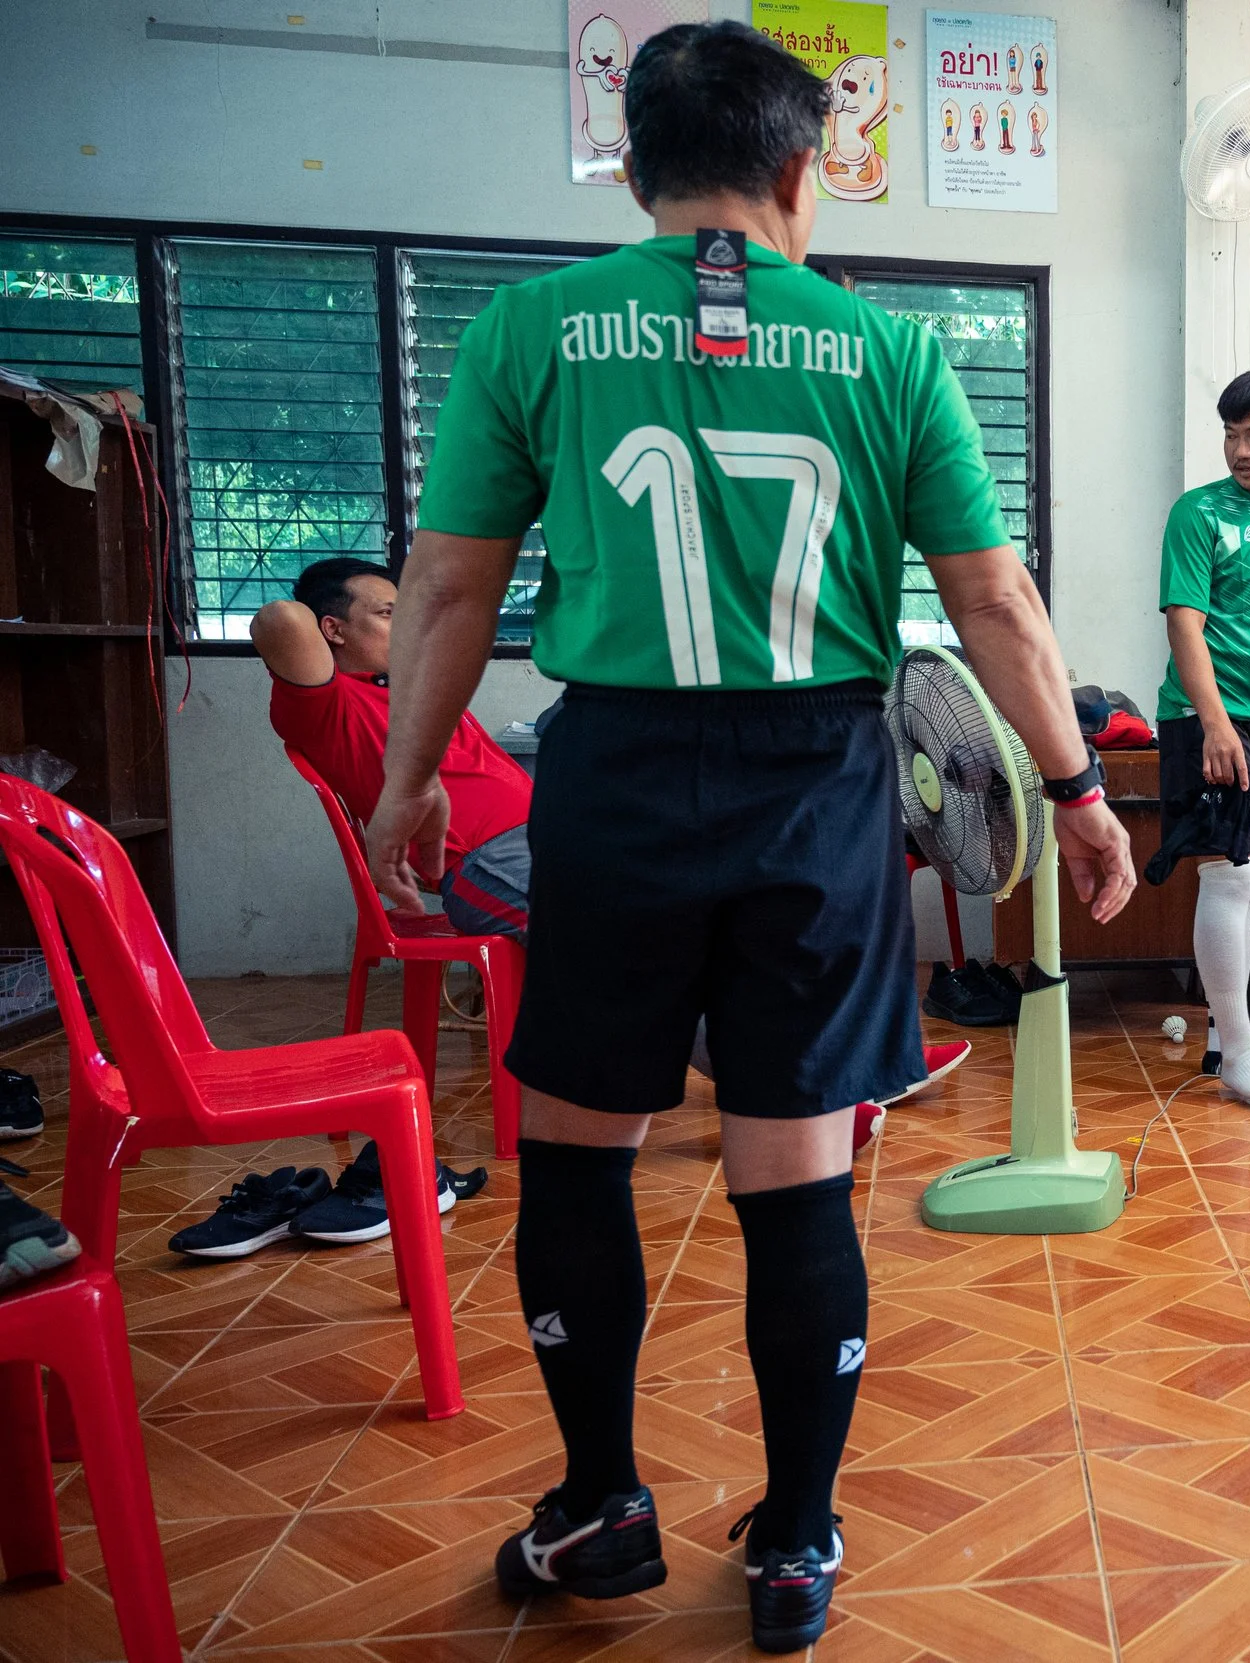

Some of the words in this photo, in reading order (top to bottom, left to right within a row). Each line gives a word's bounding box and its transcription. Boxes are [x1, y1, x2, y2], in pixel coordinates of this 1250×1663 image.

[940, 42, 998, 77] อย่า!
[936, 77, 1002, 92] ใช้เฉพาะบางคน
[601, 425, 841, 687] 17
